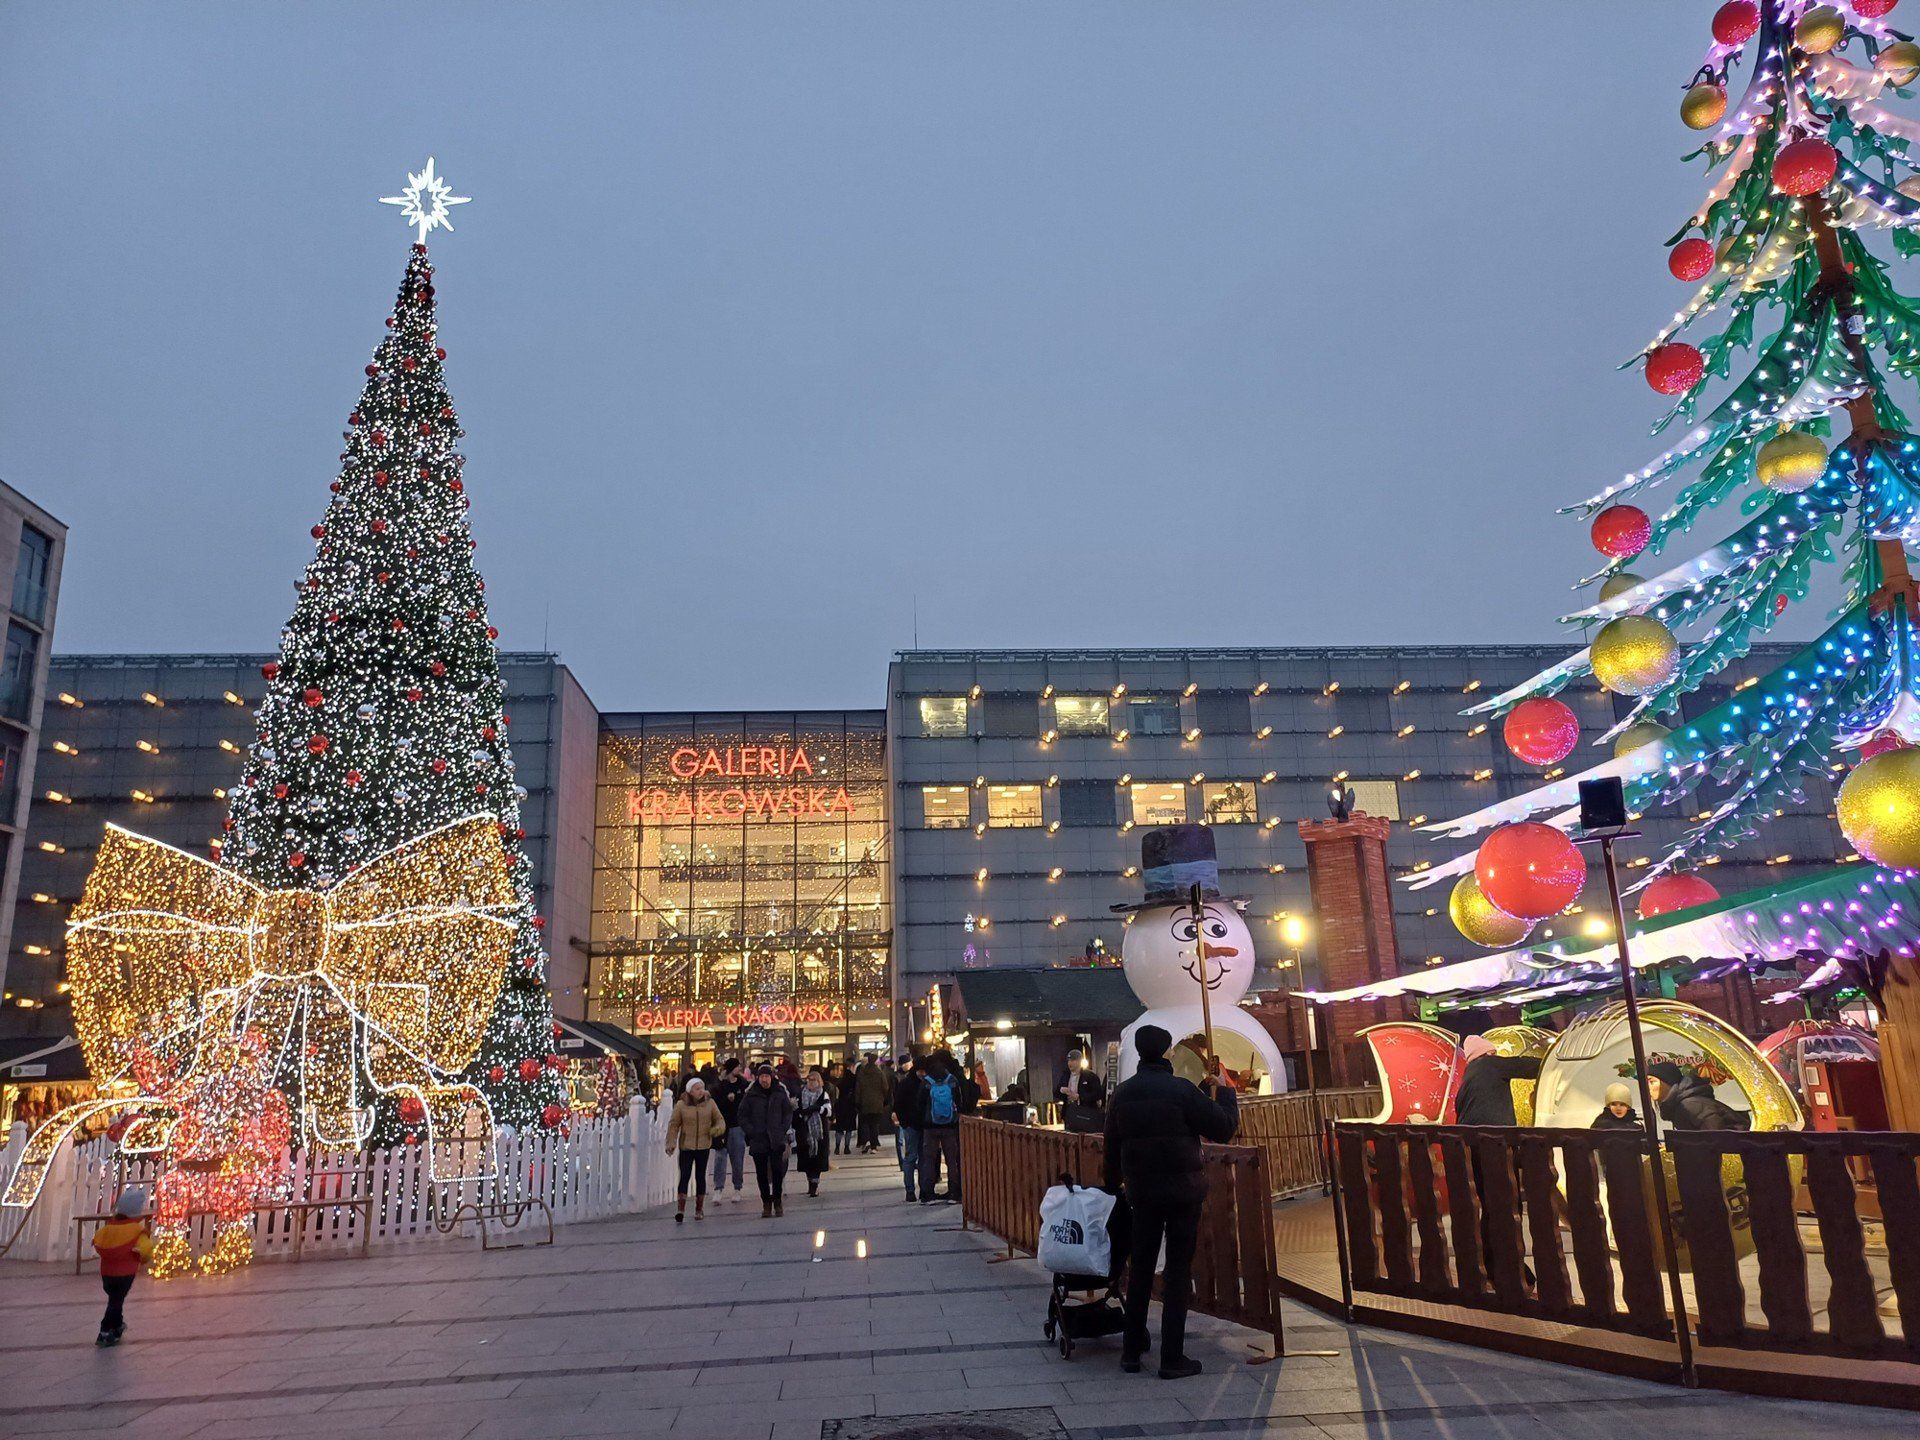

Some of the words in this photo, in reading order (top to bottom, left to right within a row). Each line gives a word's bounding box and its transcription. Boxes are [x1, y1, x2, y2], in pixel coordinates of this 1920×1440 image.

[671, 747, 813, 777] GALERIA
[628, 788, 853, 819] KRAKOWSKA
[637, 1009, 713, 1029] GALERIA
[725, 1004, 844, 1025] KRAKOWSKA
[1050, 1225, 1069, 1235] NORTH
[1053, 1233, 1069, 1244] FACE
